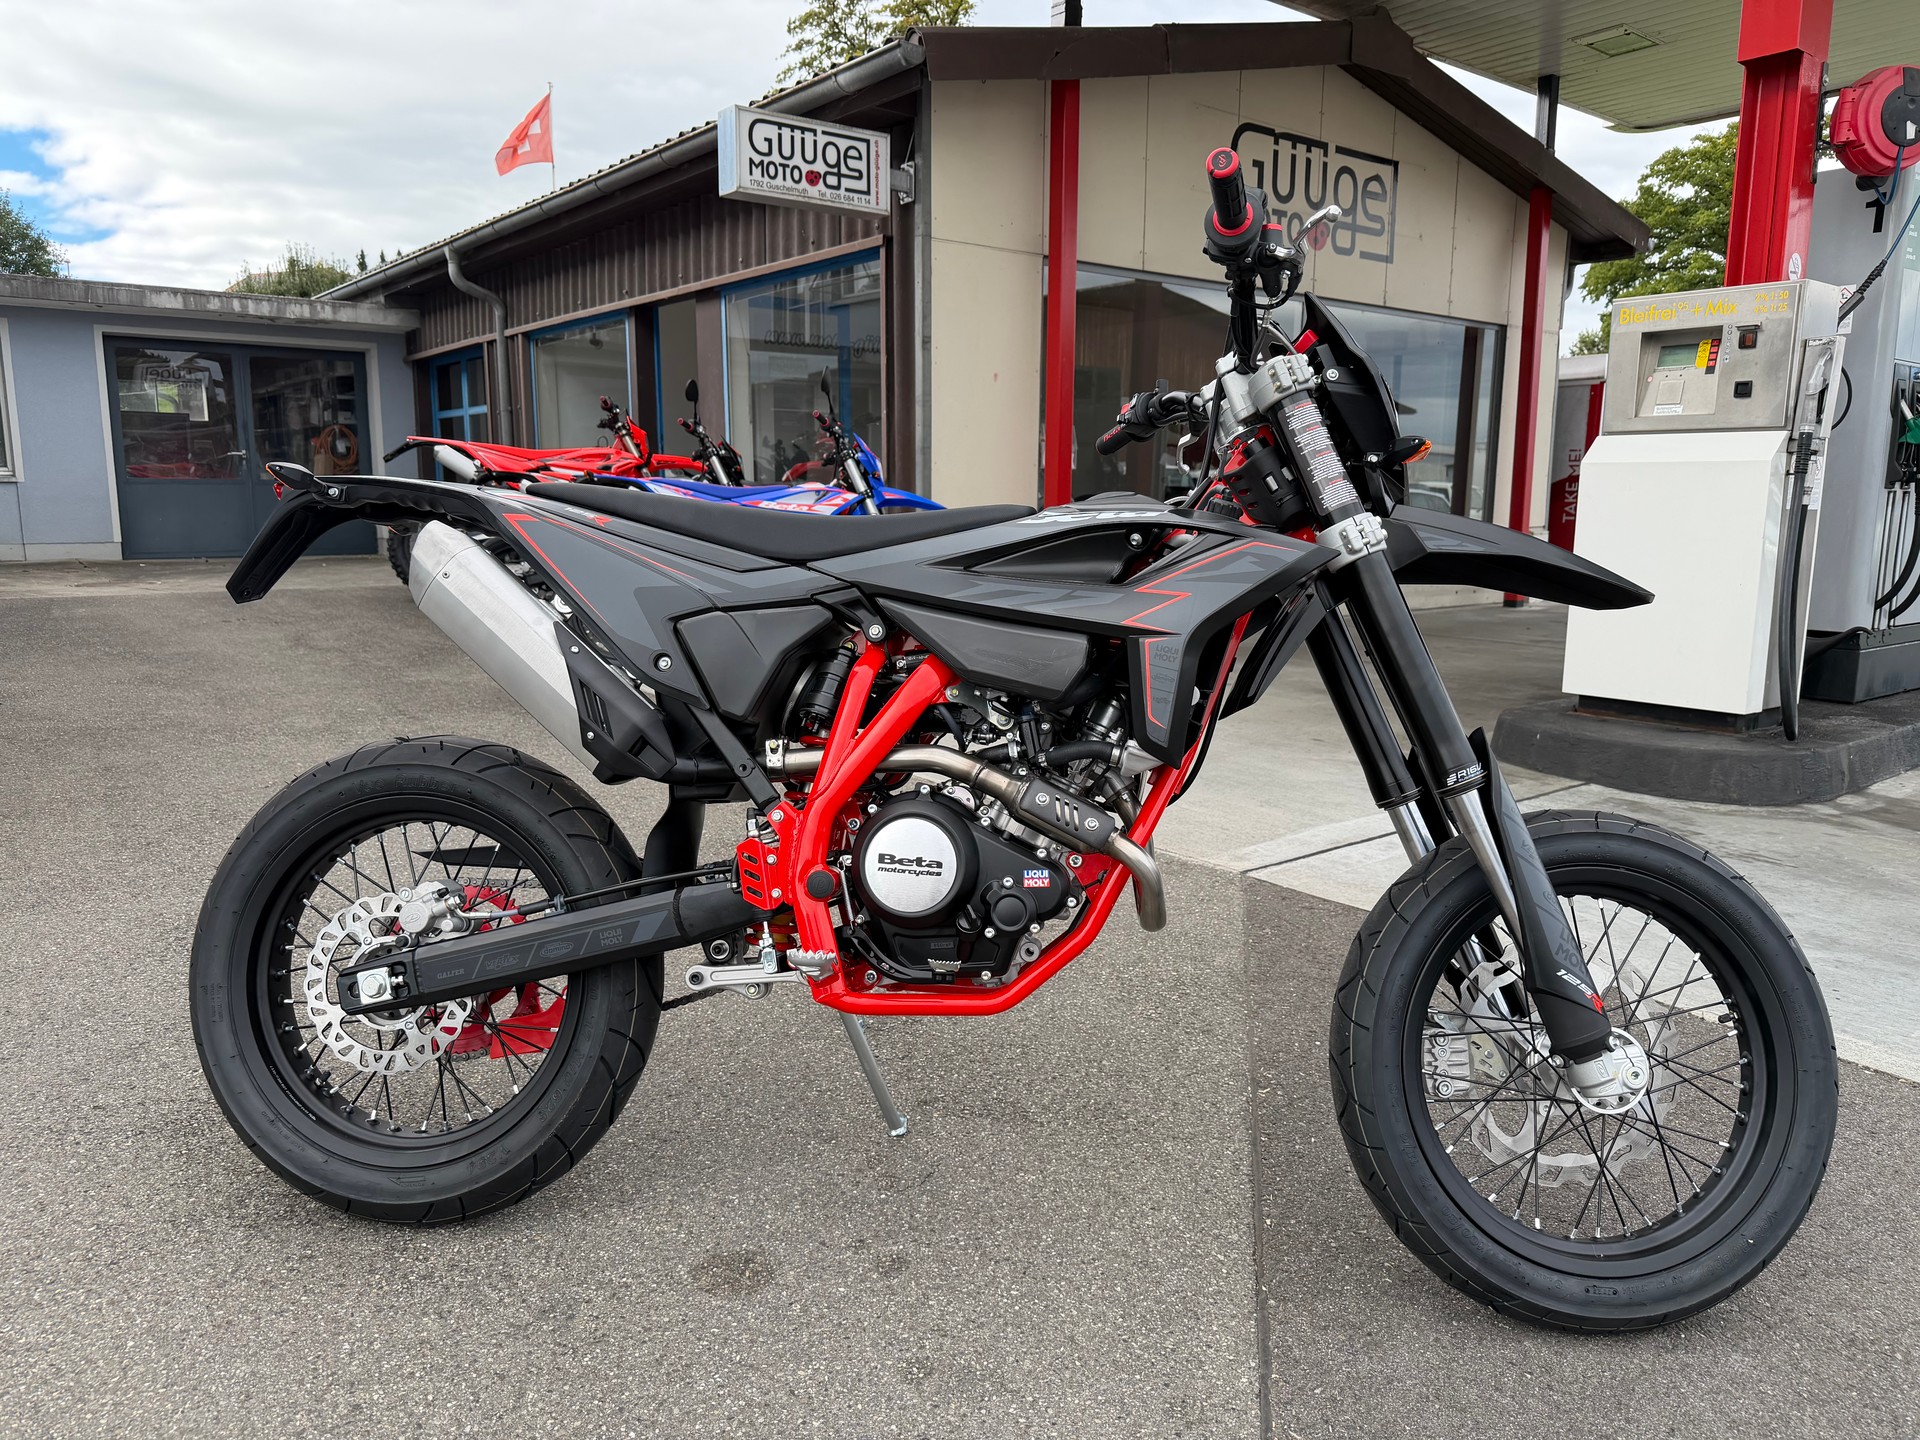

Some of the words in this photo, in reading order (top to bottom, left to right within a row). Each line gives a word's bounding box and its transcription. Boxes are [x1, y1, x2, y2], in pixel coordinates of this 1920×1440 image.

[749, 157, 803, 185] MOTO
[749, 179, 765, 188] 1792
[765, 181, 809, 196] Guschelmuth
[817, 190, 828, 198] Tel.
[857, 196, 863, 204] 11
[1865, 192, 1887, 234] 1
[1705, 298, 1738, 316] Mix
[1568, 448, 1582, 477] ME!
[759, 500, 811, 513] Beta
[1562, 481, 1579, 523] TAKE
[1156, 644, 1180, 656] LIQUI
[1153, 652, 1179, 664] MOLY
[877, 853, 944, 869] Beta
[877, 866, 942, 877] motorcycles
[1023, 869, 1050, 879] LIQUI
[1023, 879, 1050, 888] MOLY
[599, 928, 622, 940] LIQUI
[601, 935, 623, 947] MOLY
[437, 968, 465, 979] GALFER
